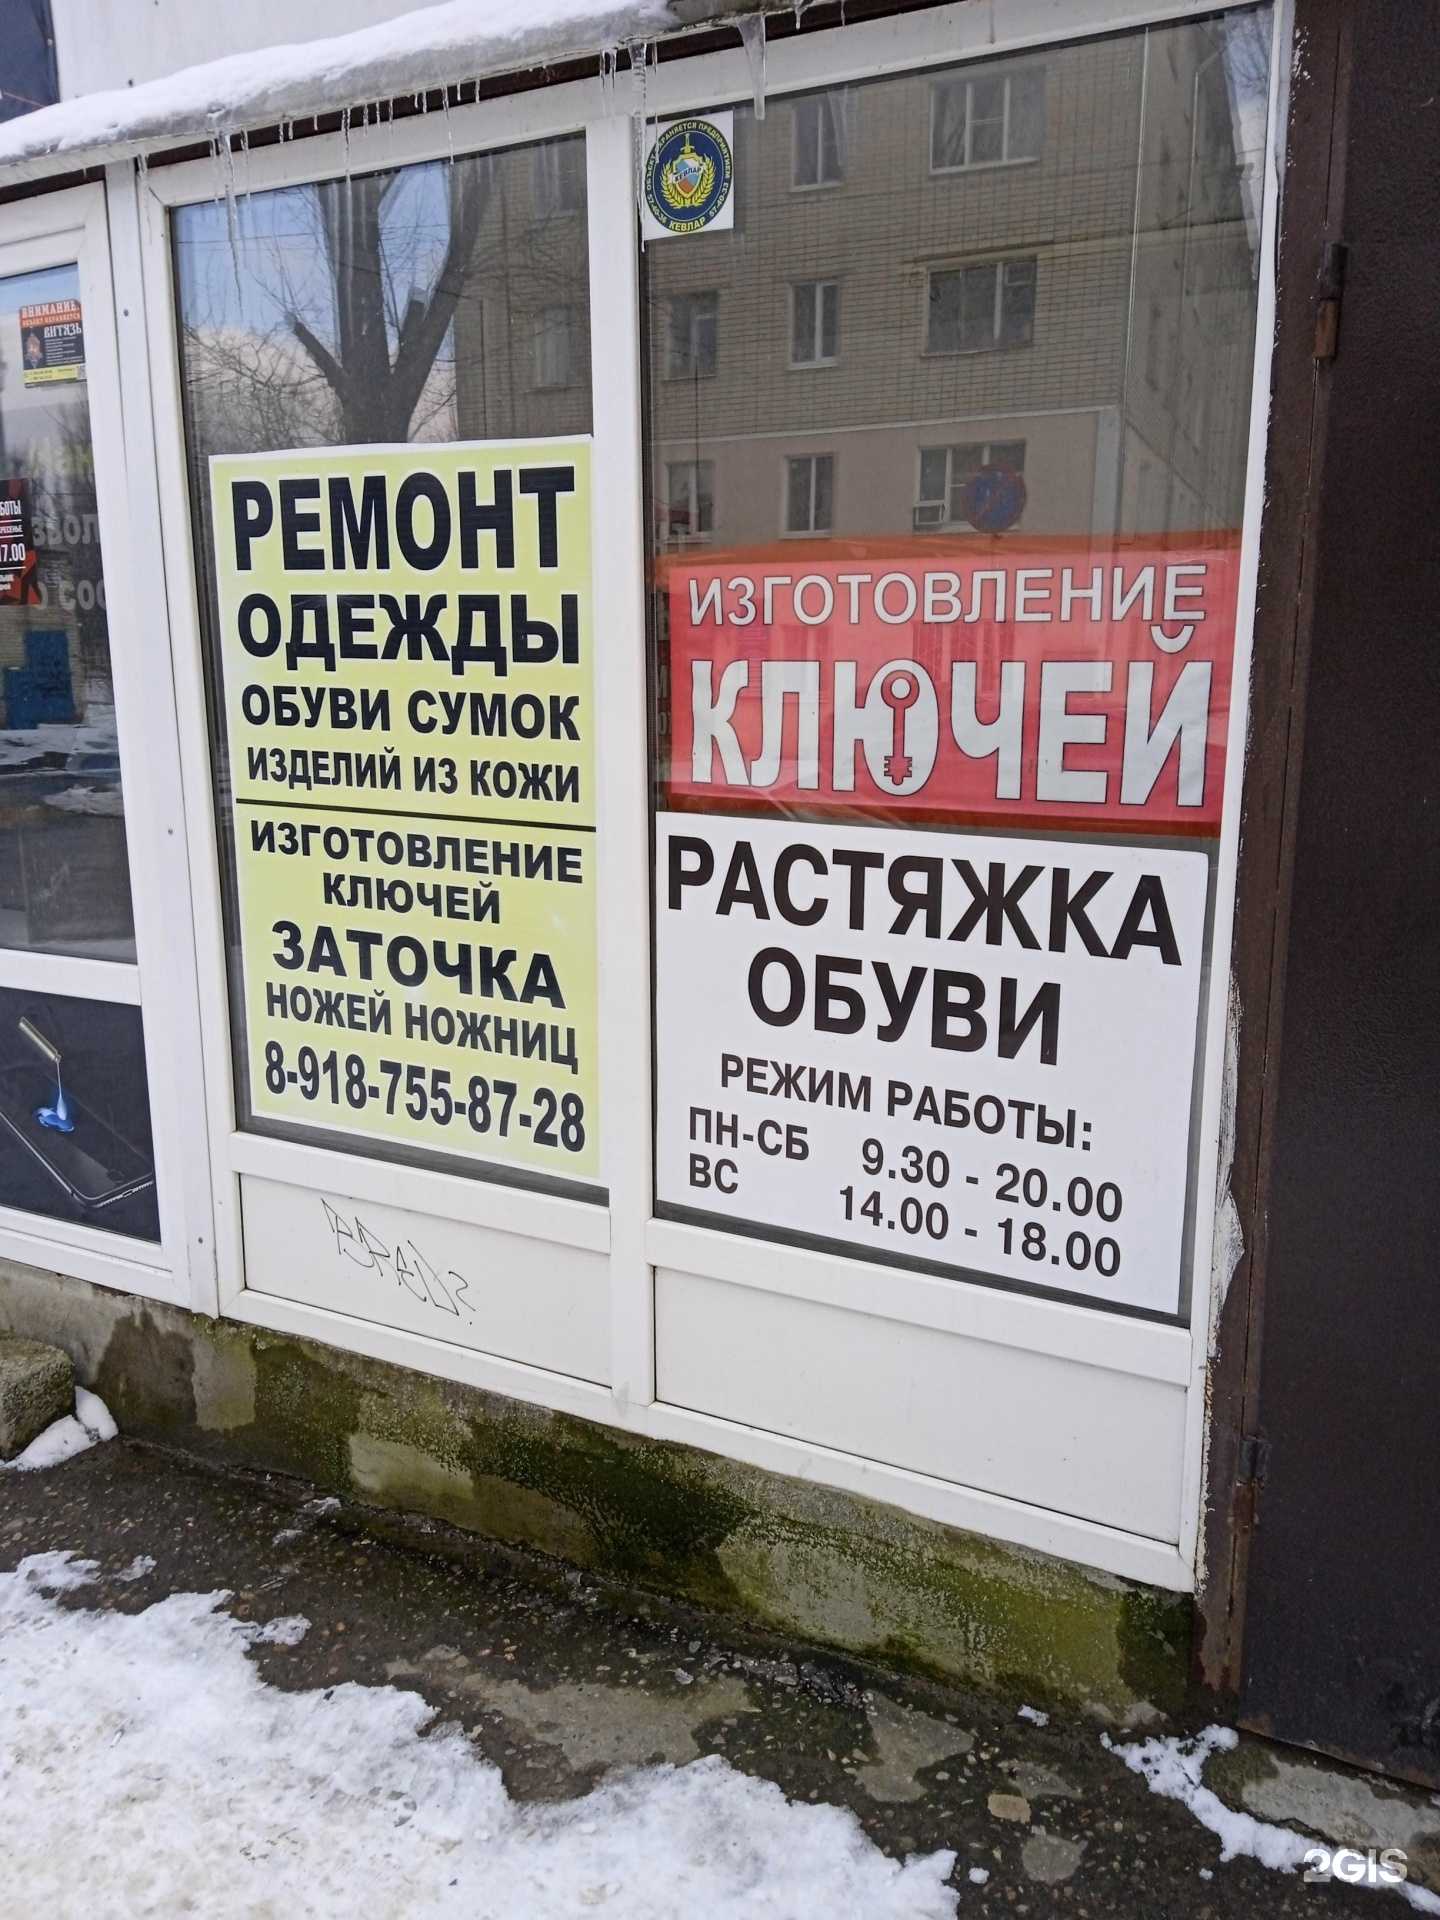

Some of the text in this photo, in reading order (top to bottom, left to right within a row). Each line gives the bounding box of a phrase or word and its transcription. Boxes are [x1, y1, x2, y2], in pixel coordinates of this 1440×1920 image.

[668, 216, 706, 232] КЕВЛАР
[44, 323, 82, 338] ВИТЯЗЬ
[231, 466, 575, 571] РЕМОНТ
[237, 593, 579, 677] ОДЕЖДЫ
[688, 564, 1208, 626] ИЗГОТОВЛЕНИЕ
[241, 684, 581, 741] ОБУВИ СУМОК
[690, 623, 1213, 808] КЛЮЧЕЙ
[247, 746, 580, 803] ИЗДЕЛИЙ ИЗ КОЖИ
[250, 820, 583, 884] ИЗГОТОВЛЕНИЕ
[322, 872, 500, 925] КЛЮЧЕЙ
[667, 834, 1183, 967] РАСТЯЖКА
[271, 920, 566, 1009] ЗАТОЧКА
[747, 946, 1062, 1066] ОБУВИ
[266, 981, 579, 1075] НОЖЕЙ НОЖНИЦ
[265, 1040, 586, 1153] 8-918-755-87-28
[721, 1053, 1093, 1151] РЕЖИМ РАБОТЫ:
[689, 1106, 810, 1161] ПН-СБ
[862, 1138, 950, 1189] 9.30
[995, 1163, 1123, 1223] 20.00
[689, 1152, 739, 1194] ВС
[839, 1185, 949, 1240] 14.00
[997, 1217, 1121, 1277] 18.00
